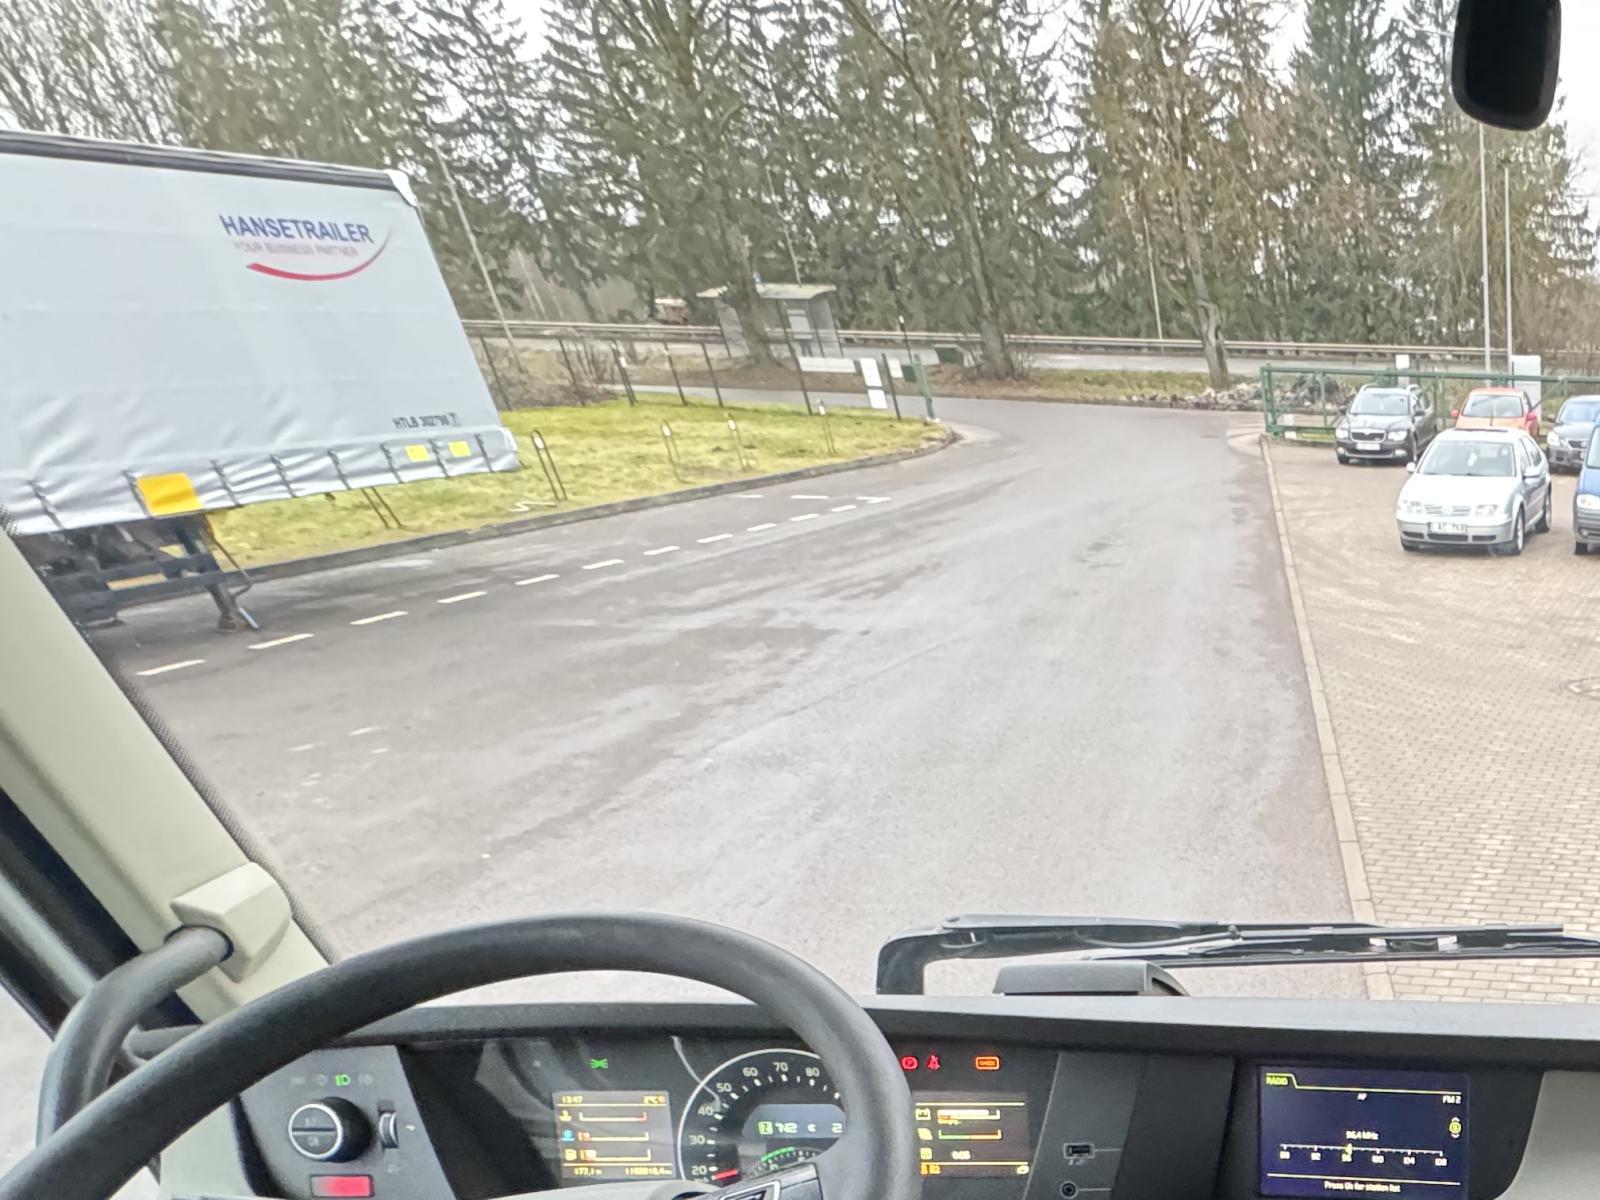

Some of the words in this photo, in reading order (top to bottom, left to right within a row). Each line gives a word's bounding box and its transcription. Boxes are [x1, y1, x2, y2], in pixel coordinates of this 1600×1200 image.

[219, 214, 375, 244] HANSETRAILER
[742, 1067, 758, 1077] 60
[773, 1062, 789, 1072] 70
[805, 1068, 820, 1077] 80
[1266, 1076, 1288, 1086] RADIO
[716, 1083, 732, 1092] 50
[698, 1107, 714, 1116] 40
[689, 1135, 705, 1145] 30
[691, 1165, 707, 1175] 20
